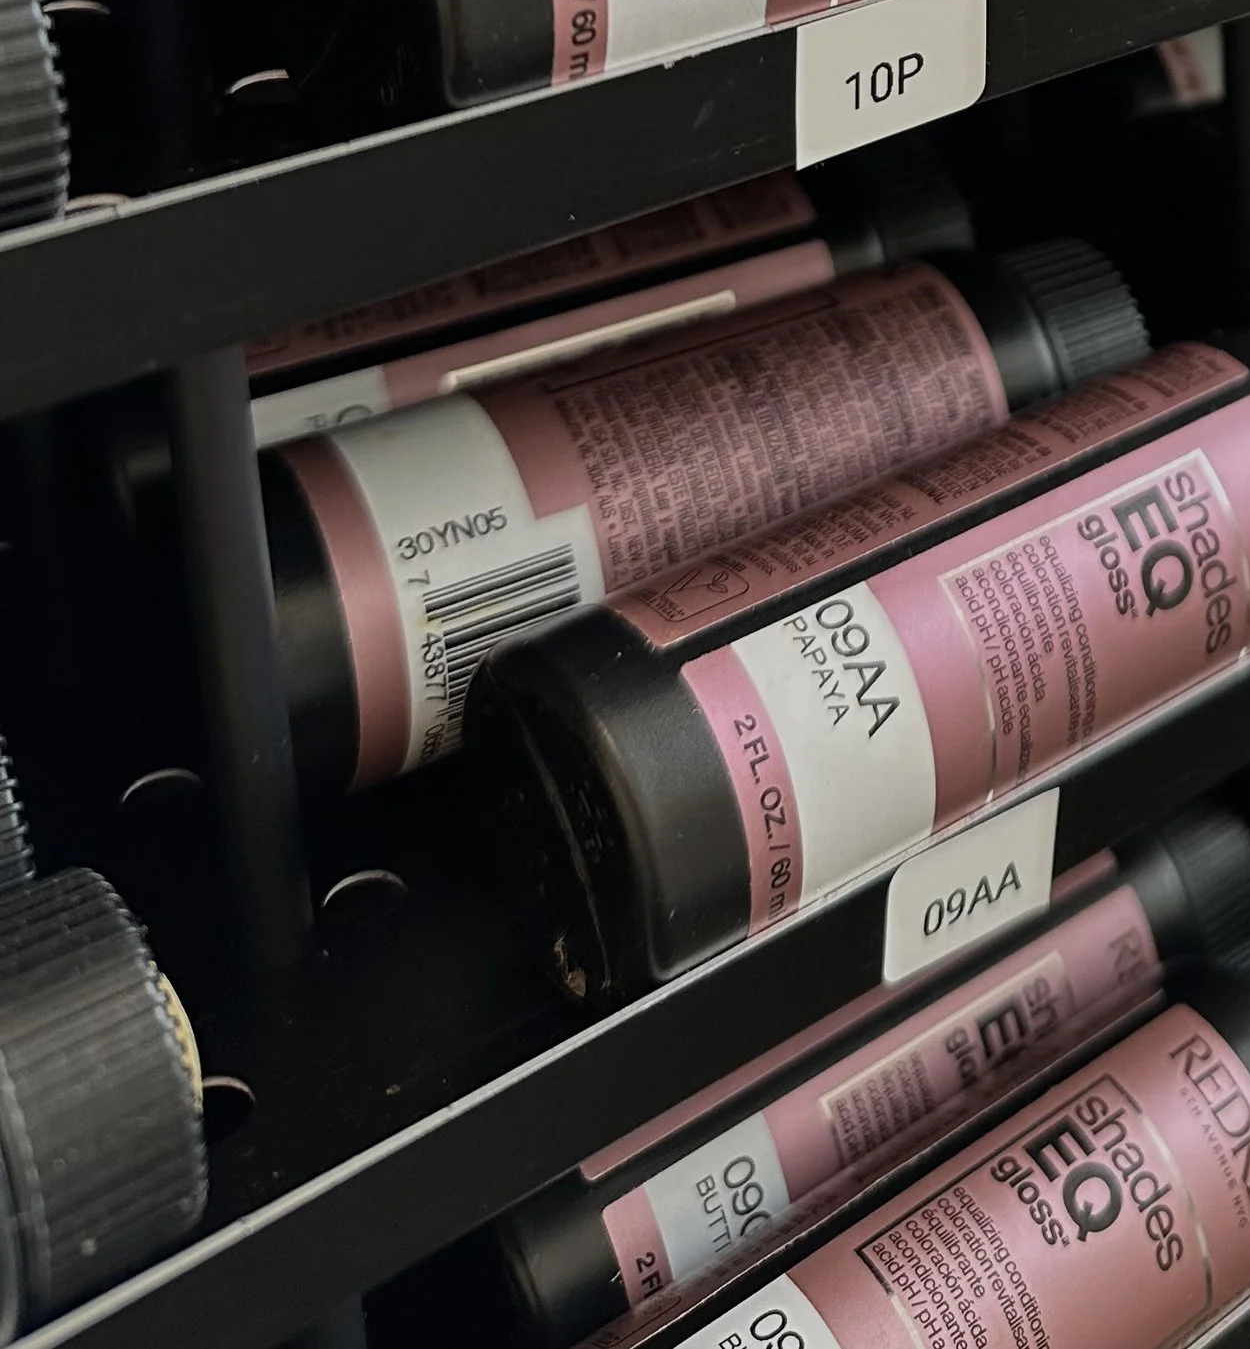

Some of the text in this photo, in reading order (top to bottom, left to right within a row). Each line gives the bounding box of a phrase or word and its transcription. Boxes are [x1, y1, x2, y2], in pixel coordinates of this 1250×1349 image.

[571, 10, 597, 47] 60
[844, 51, 925, 111] 10P
[397, 506, 508, 561] 30YN05
[1110, 483, 1195, 618] EQ
[1163, 469, 1238, 654] shades
[955, 575, 986, 614] acid
[1006, 549, 1054, 655] équilibrante
[1022, 542, 1066, 631] coloration
[1038, 534, 1083, 624] equalizing
[815, 598, 902, 739] 09AA
[972, 614, 997, 645] pH
[972, 566, 1028, 704] acondicionante
[989, 558, 1047, 703] coloración ácida
[783, 614, 850, 727] PAPAYA
[987, 656, 1008, 686] pH
[733, 714, 757, 738] 2
[995, 685, 1014, 736] acide
[743, 735, 770, 785] FL.
[760, 786, 787, 841] OZ.
[768, 843, 791, 852] /
[770, 857, 792, 890] 60
[923, 860, 1023, 937] 09AA
[1022, 1114, 1124, 1243] EQ
[1075, 1094, 1185, 1272] shades
[1201, 1122, 1237, 1188] AVENUE
[635, 1251, 656, 1274] 2
[905, 1218, 964, 1305] coloración
[919, 1206, 986, 1299] équilibrante
[936, 1196, 996, 1274] coloration
[952, 1185, 1010, 1263] equalizing
[872, 1241, 903, 1277] acid
[893, 1276, 921, 1302] pH
[914, 1307, 942, 1334] pH
